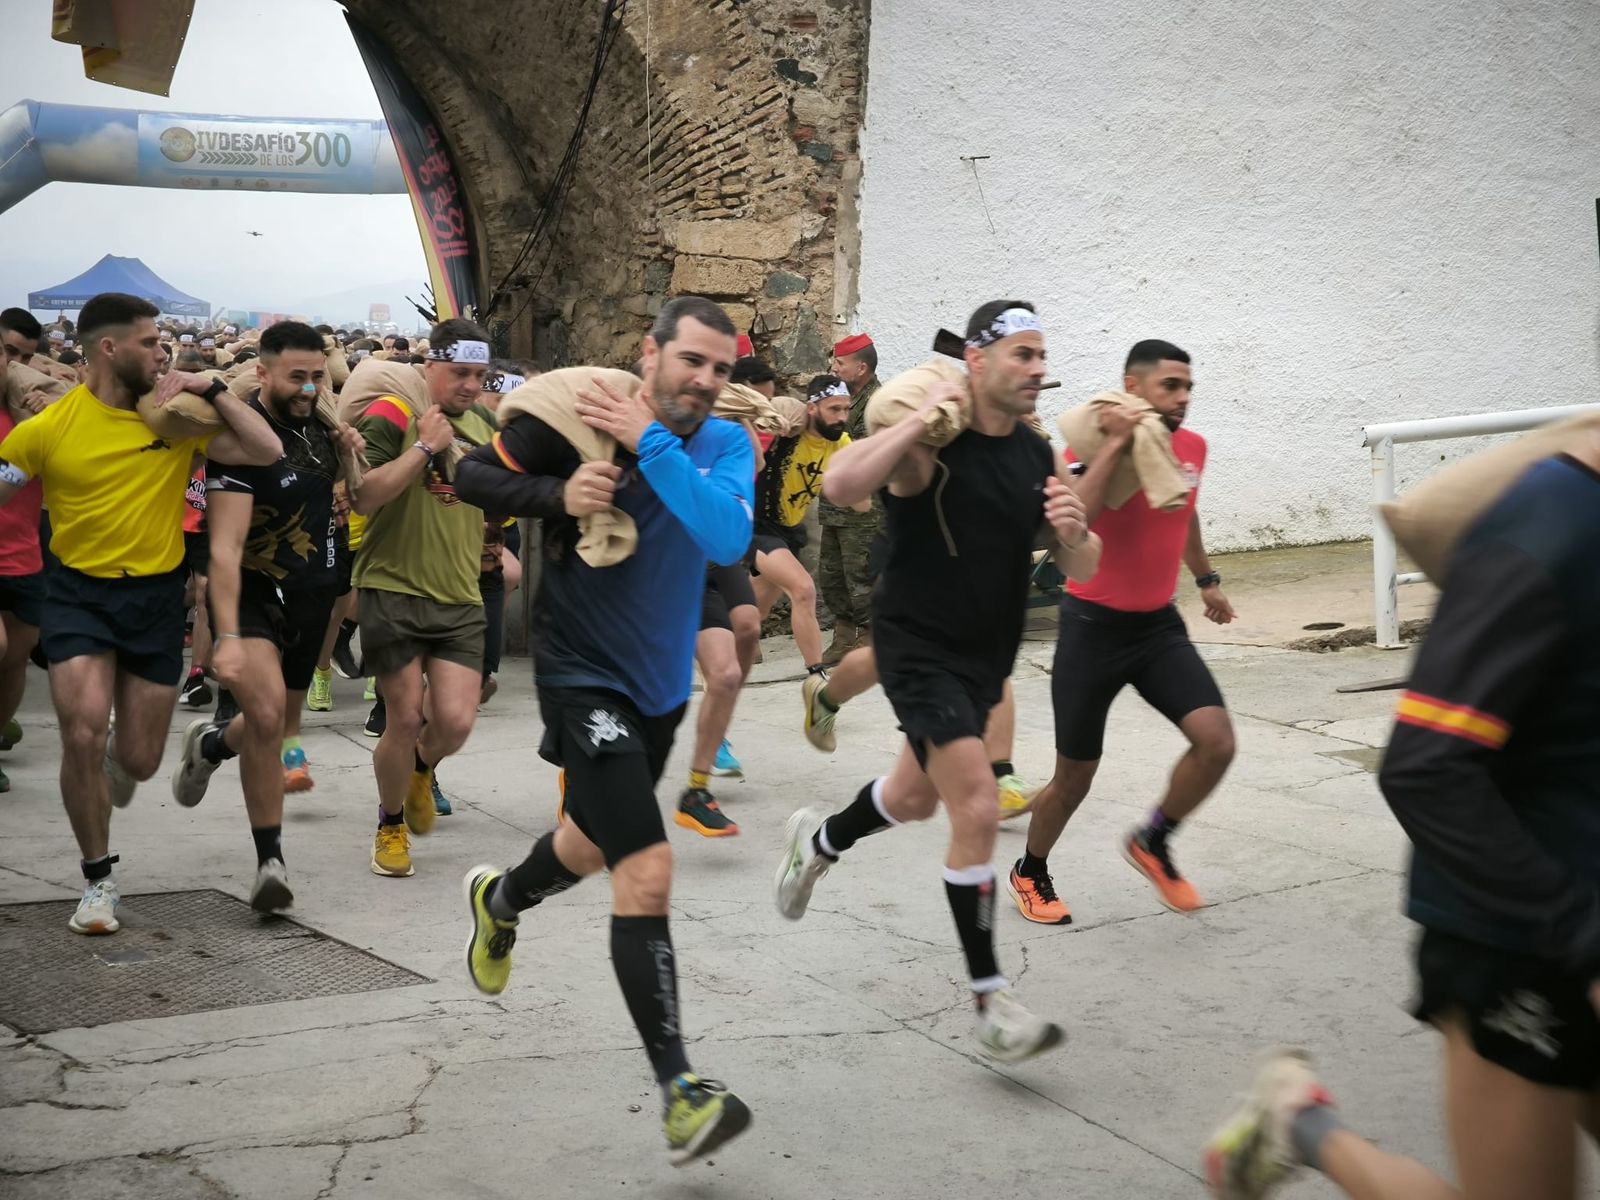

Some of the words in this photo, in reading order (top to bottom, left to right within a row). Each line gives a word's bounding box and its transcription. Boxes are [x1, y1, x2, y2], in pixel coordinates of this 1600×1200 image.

[295, 131, 351, 167] 300
[260, 153, 272, 166] DE
[276, 154, 294, 167] LOS
[280, 472, 298, 488] 54
